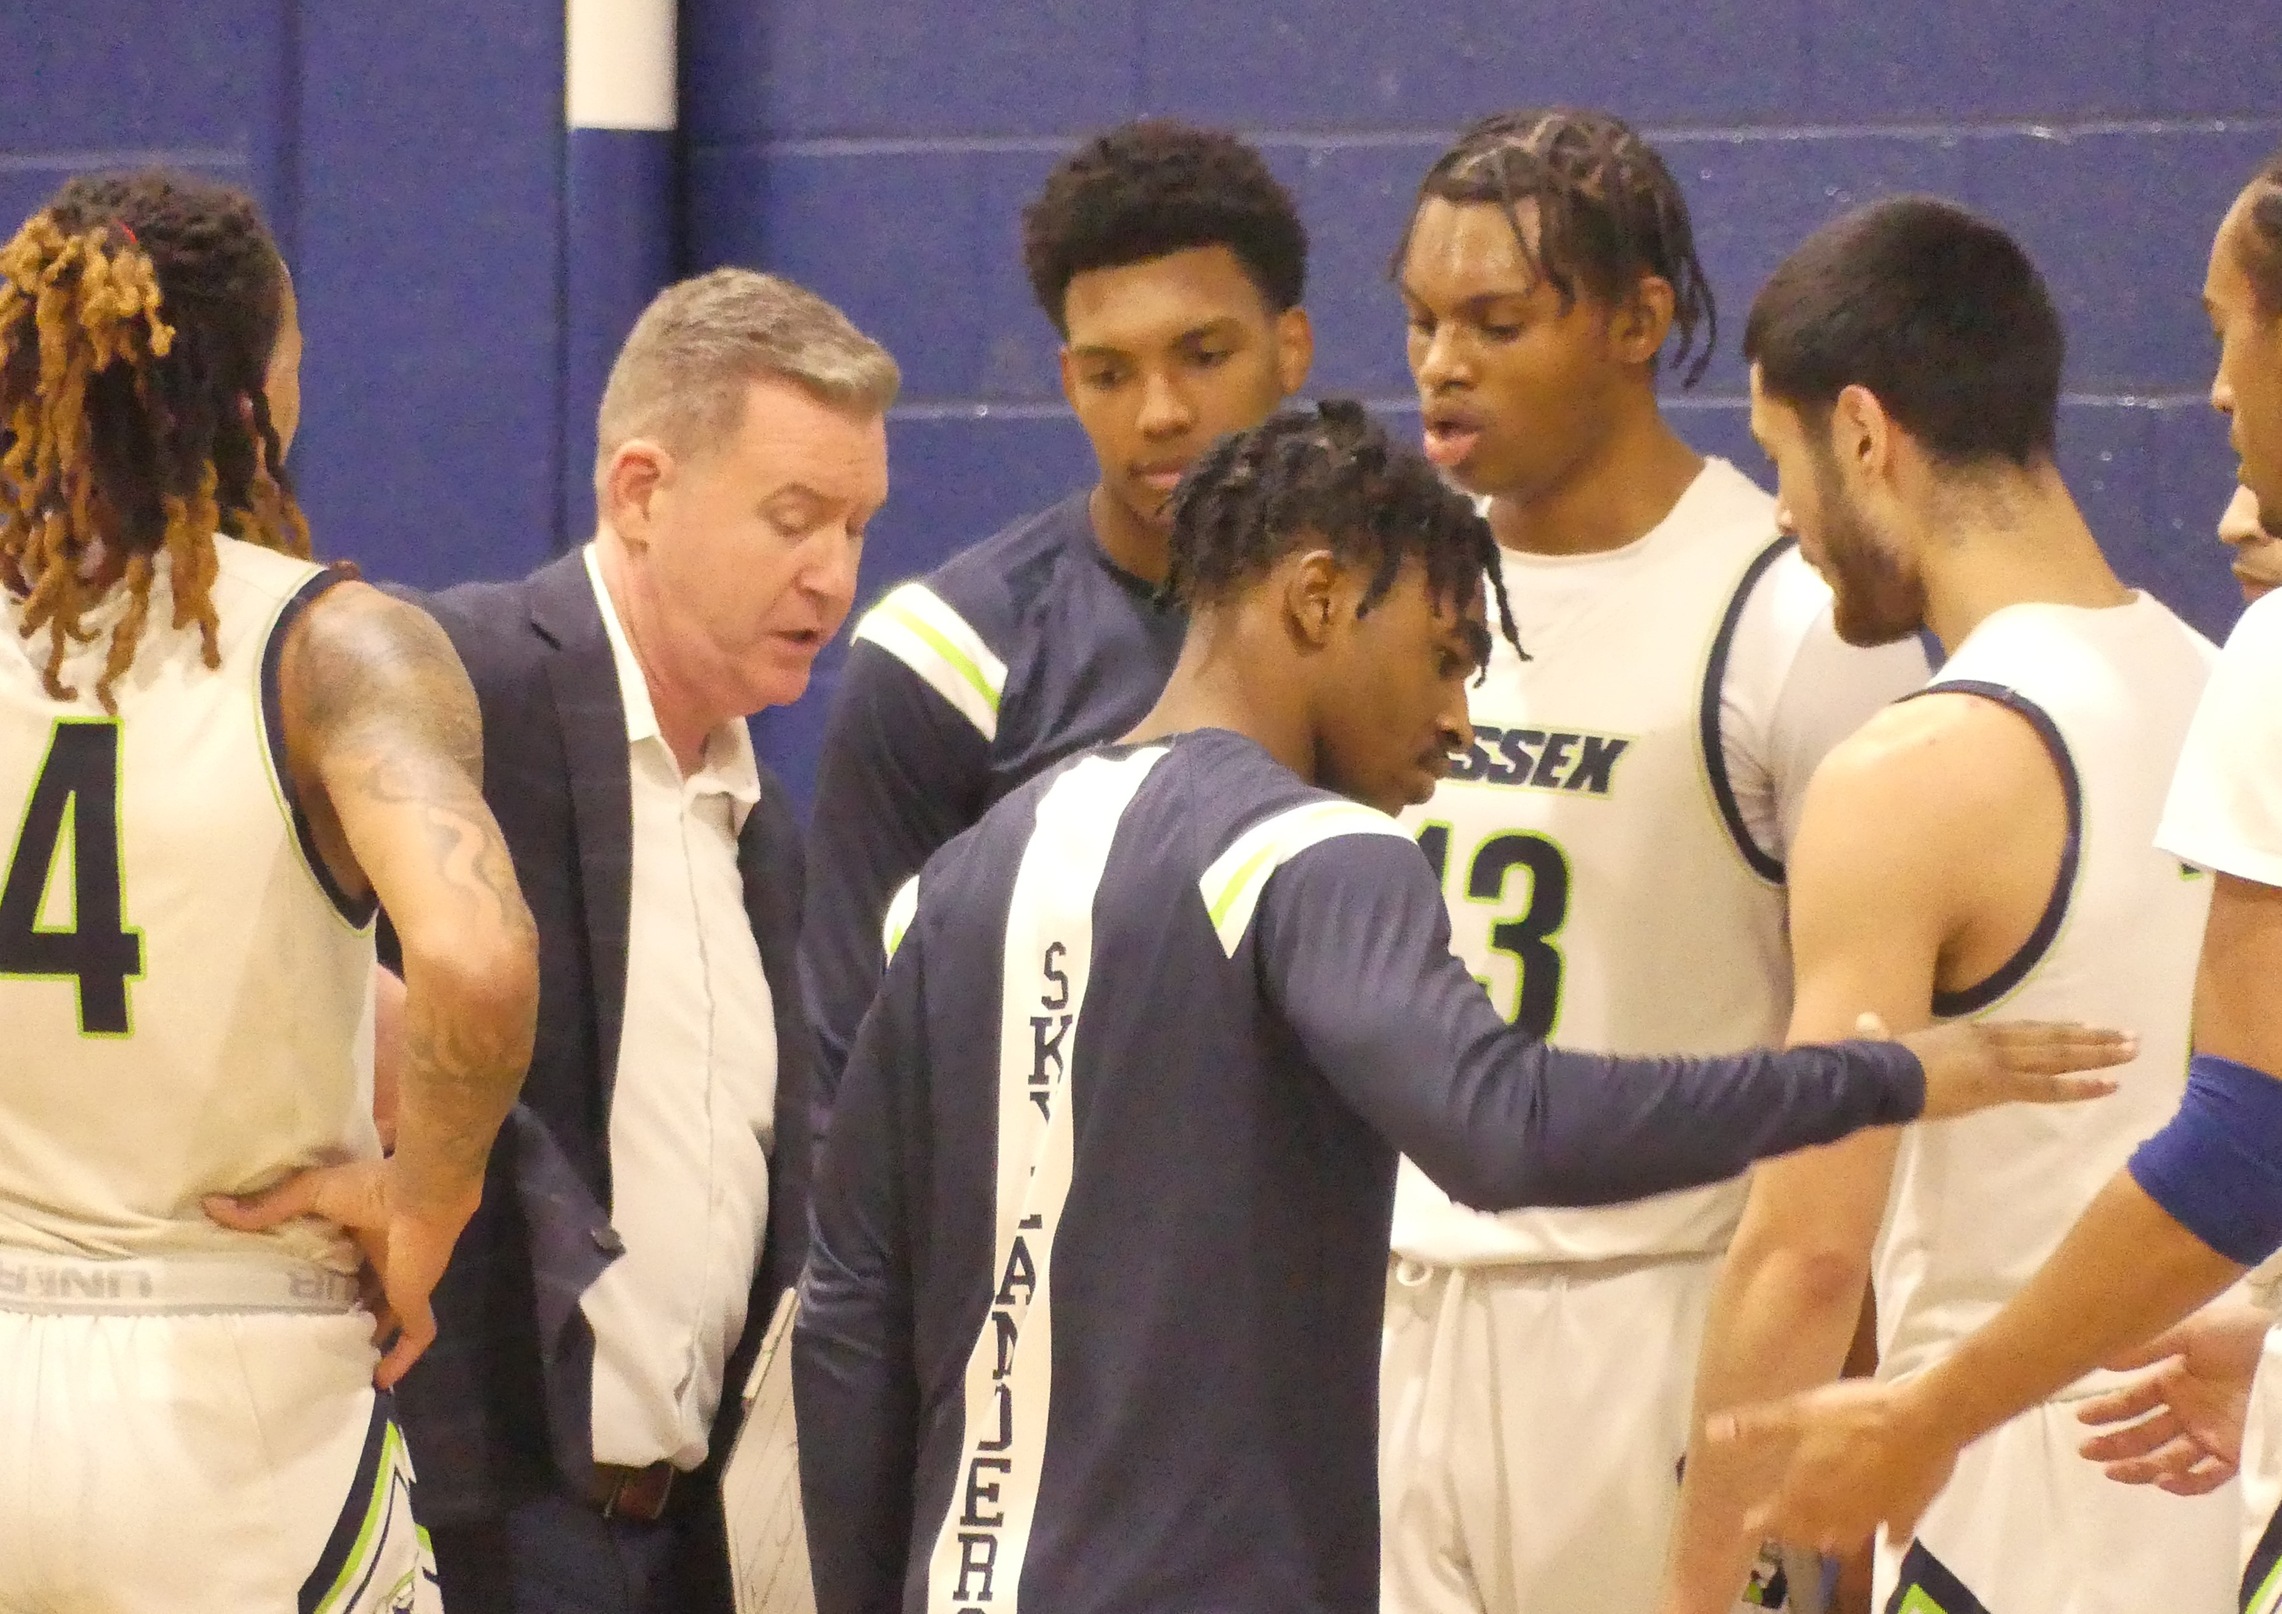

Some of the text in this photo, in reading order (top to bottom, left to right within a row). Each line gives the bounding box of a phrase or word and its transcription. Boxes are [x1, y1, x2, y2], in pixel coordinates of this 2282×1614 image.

[1448, 724, 1630, 794] SSEX
[0, 716, 146, 1038] 4
[1414, 818, 1573, 1046] 3
